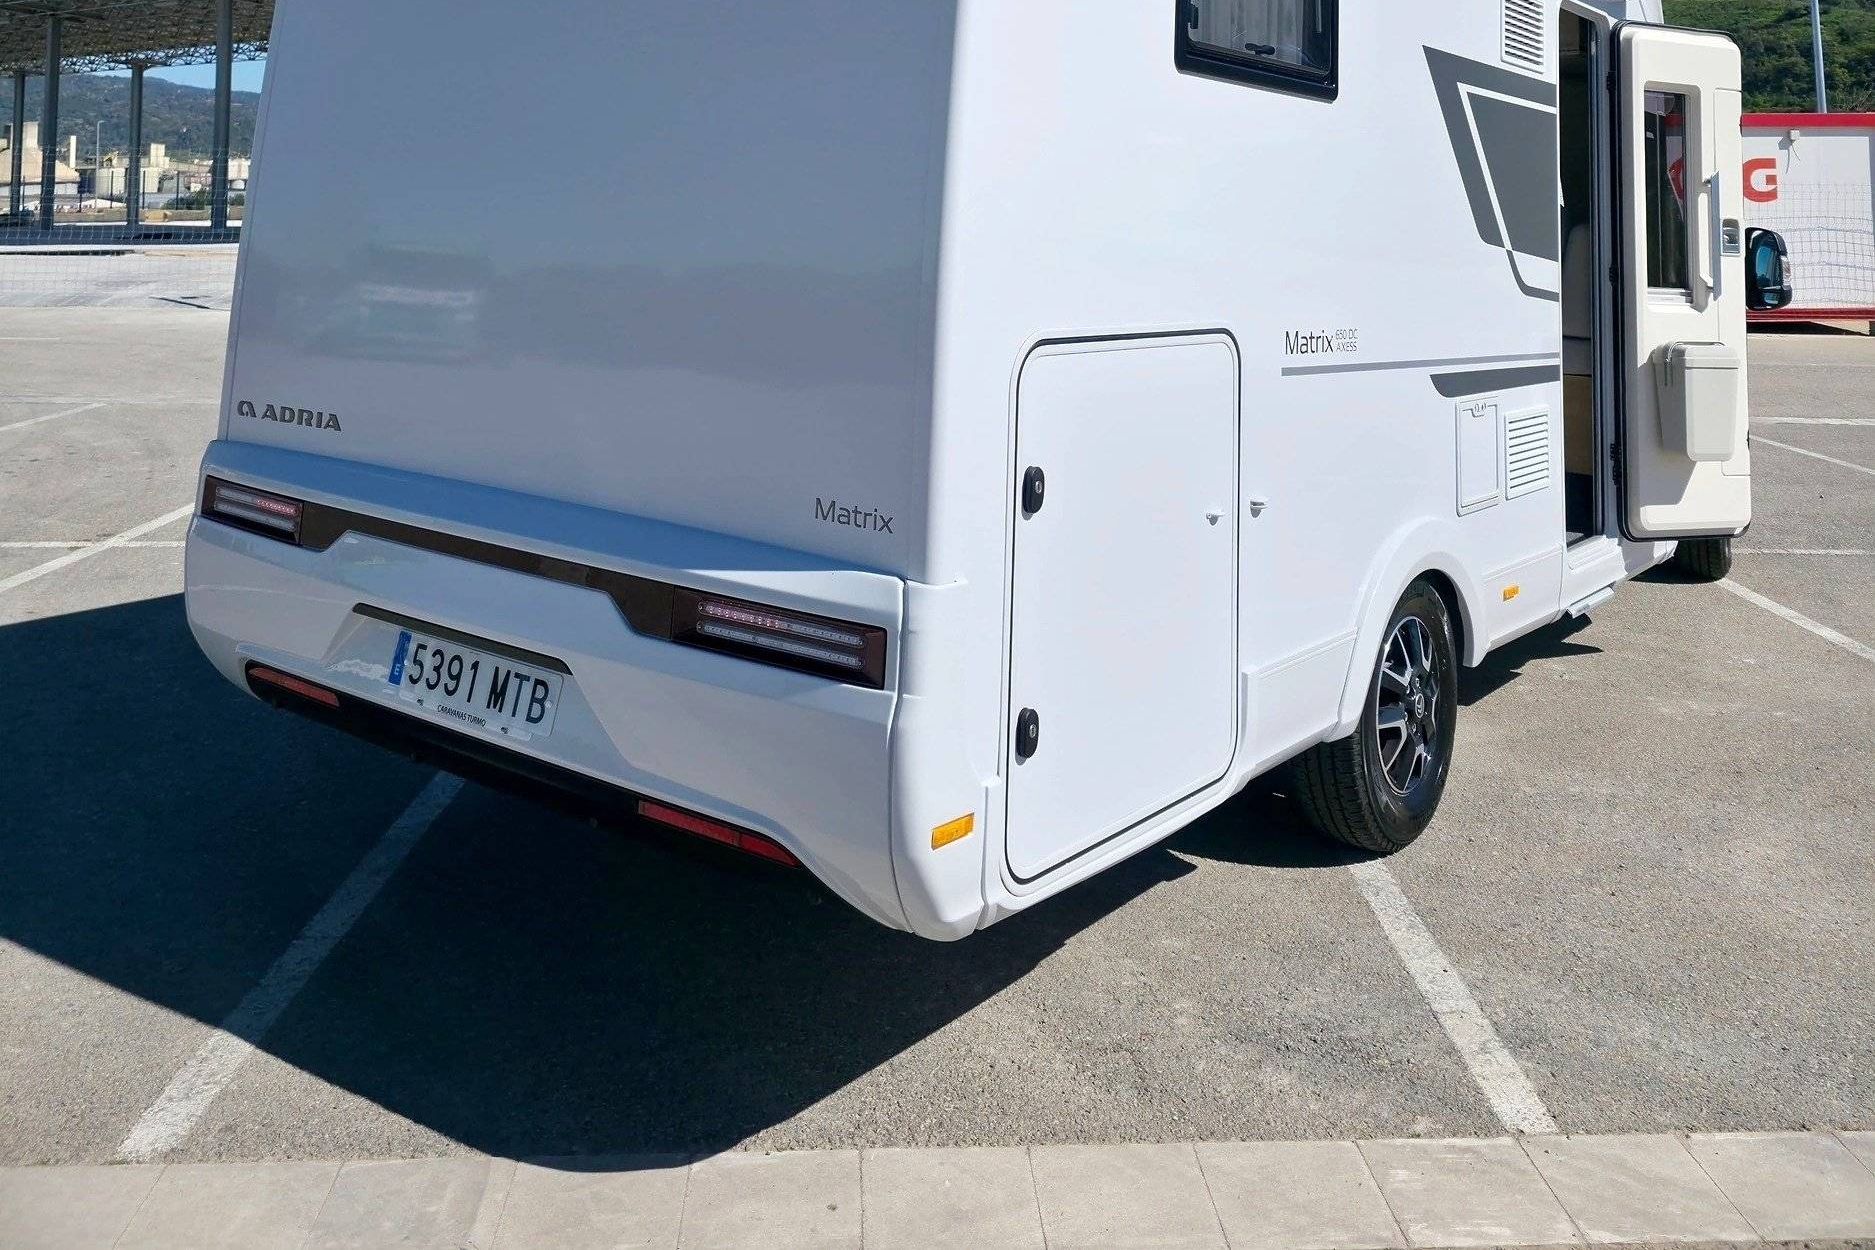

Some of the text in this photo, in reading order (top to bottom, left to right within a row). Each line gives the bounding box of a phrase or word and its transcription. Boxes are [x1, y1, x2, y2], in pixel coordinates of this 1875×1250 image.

[1743, 157, 1778, 203] G
[1285, 329, 1334, 355] Matrix
[1336, 341, 1358, 352] AXESS
[261, 403, 342, 432] ADRIA
[815, 497, 893, 534] Matrix
[393, 664, 401, 676] E
[408, 643, 550, 725] 5391 MTB
[437, 704, 487, 728] CARAVANAS TURMO
